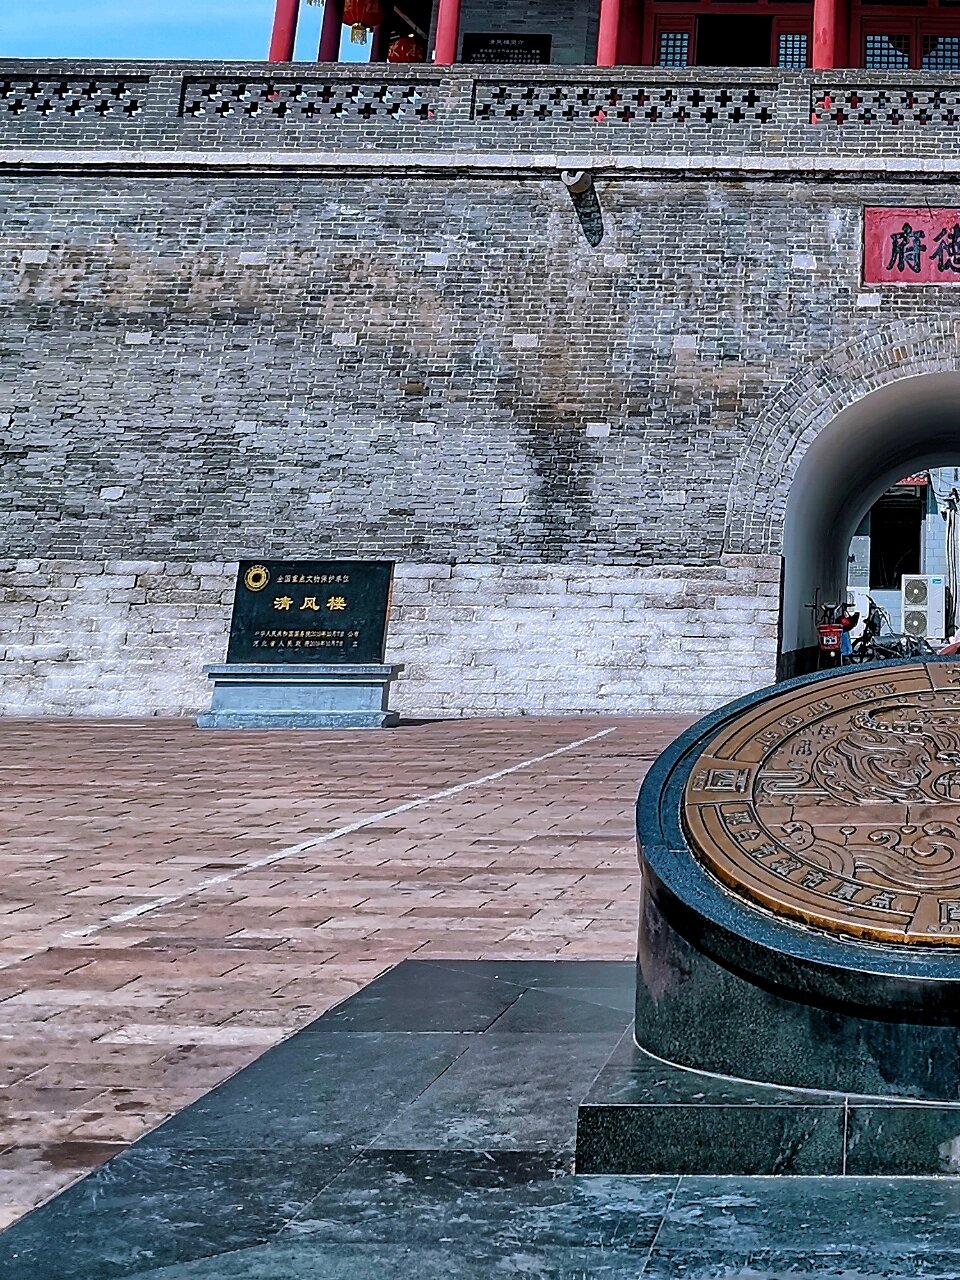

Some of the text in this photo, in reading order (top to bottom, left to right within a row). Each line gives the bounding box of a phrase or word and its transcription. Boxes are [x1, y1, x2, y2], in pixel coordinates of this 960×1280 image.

[276, 574, 350, 584] 全国重点文物保护单位
[273, 595, 347, 611] 清风楼
[705, 767, 750, 794] 西
